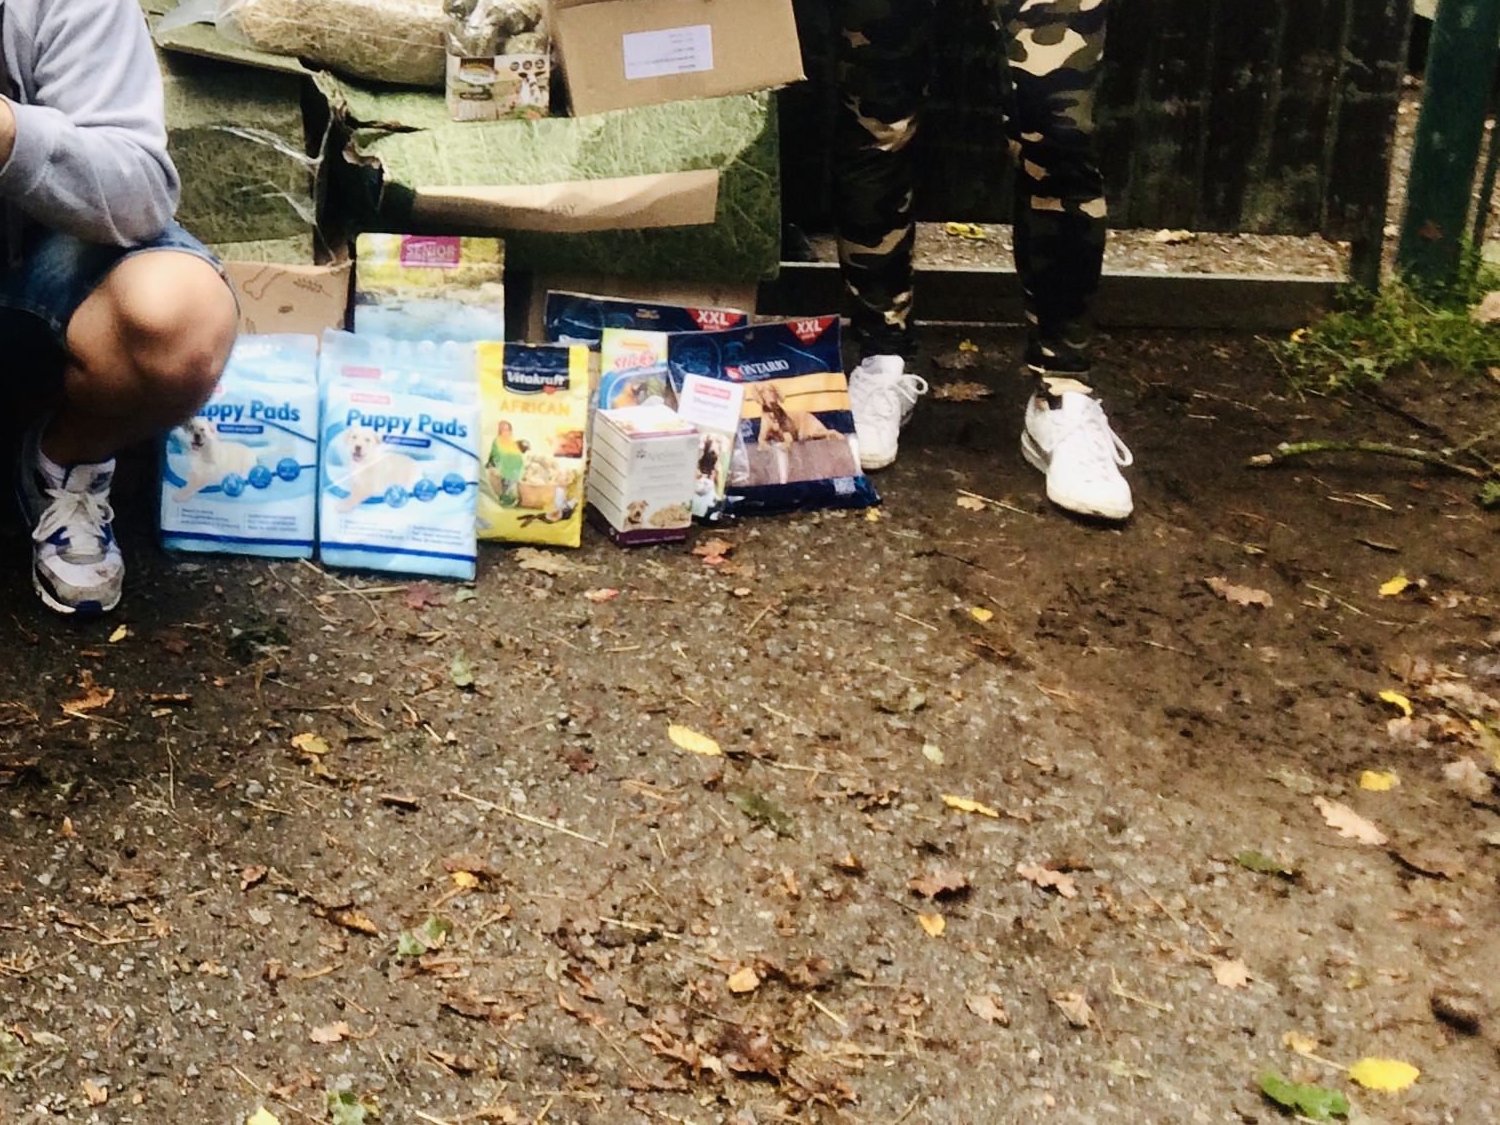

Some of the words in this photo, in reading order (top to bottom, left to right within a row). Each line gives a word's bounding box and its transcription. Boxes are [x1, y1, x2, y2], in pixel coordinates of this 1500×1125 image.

[697, 310, 729, 325] XXL
[795, 320, 823, 335] XXL
[739, 359, 790, 376] ONTARIO
[507, 371, 566, 387] Vitakraft
[250, 399, 301, 422] Pads
[500, 398, 571, 416] AFRICAN
[346, 408, 413, 435] Puppy
[418, 412, 468, 438] Pads
